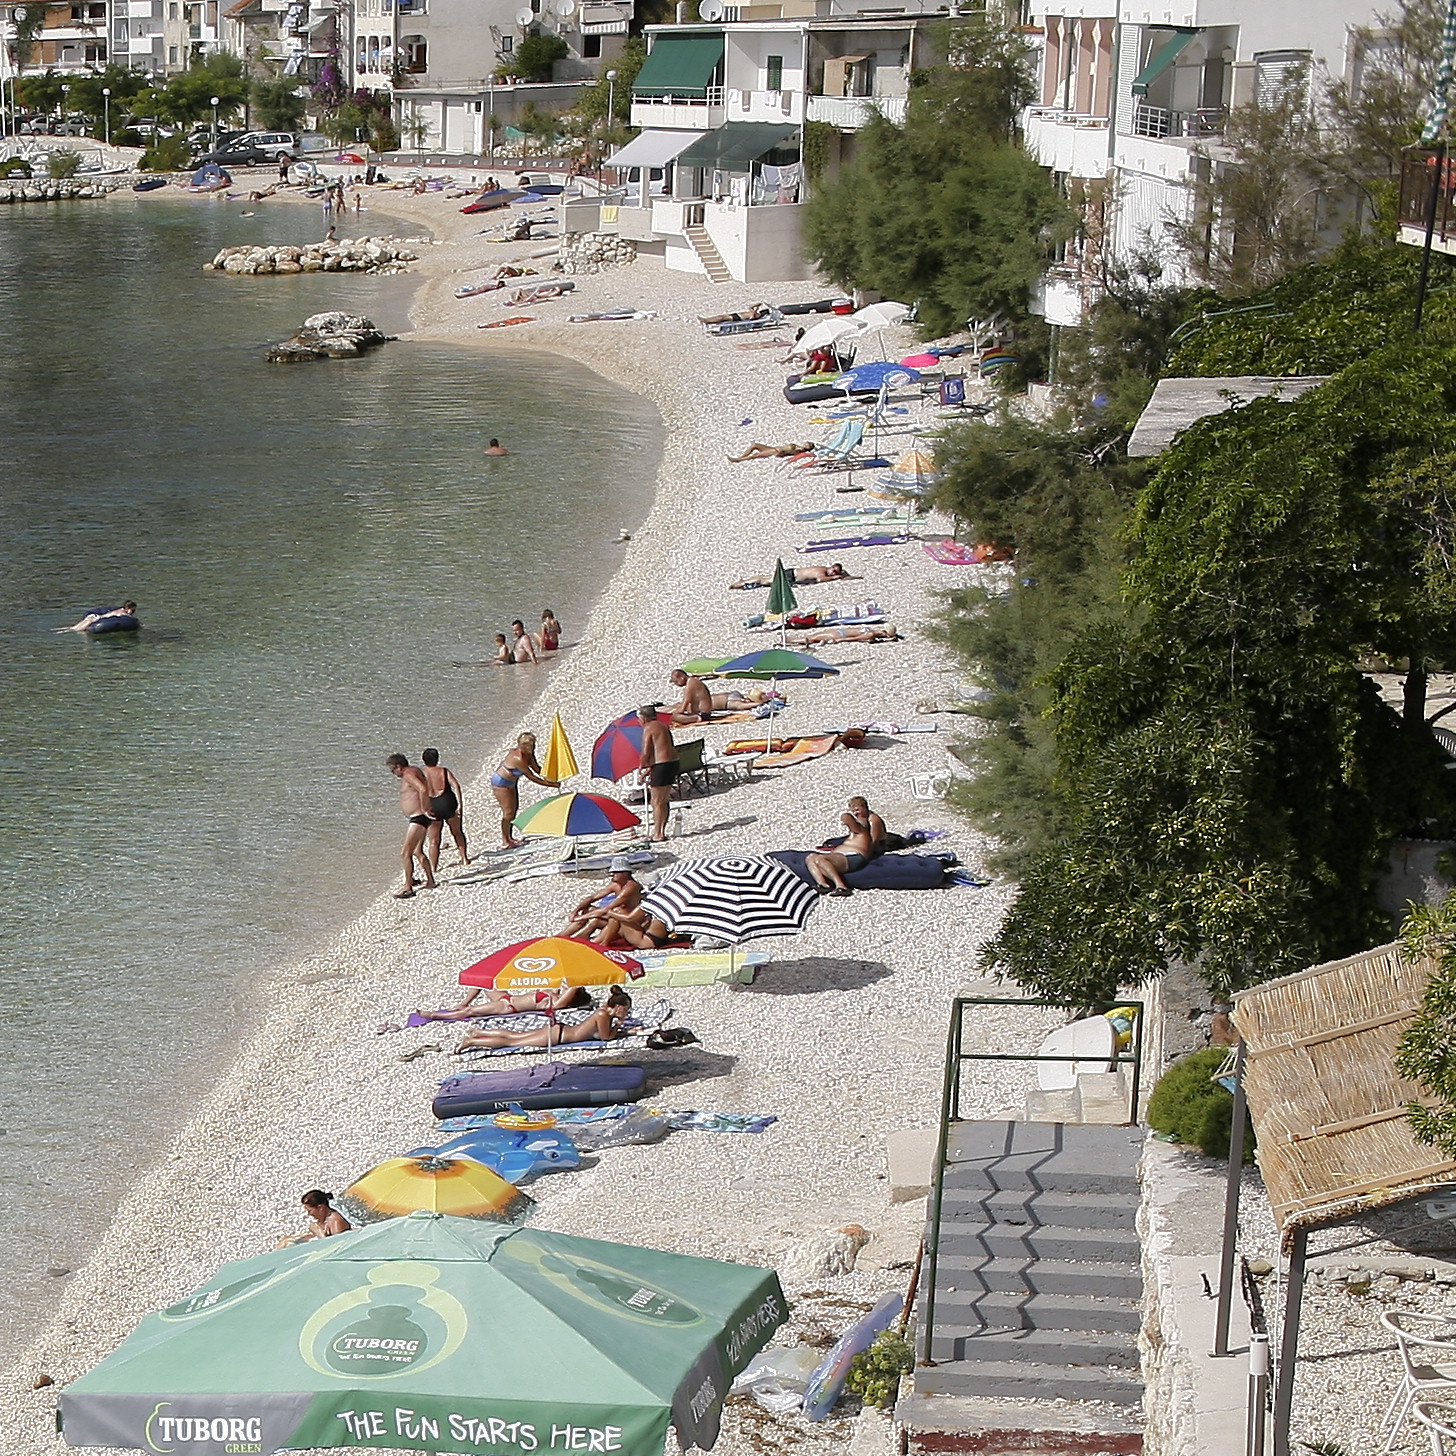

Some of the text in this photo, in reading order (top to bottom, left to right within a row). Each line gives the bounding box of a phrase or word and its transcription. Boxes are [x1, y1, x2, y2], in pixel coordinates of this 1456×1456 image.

[344, 1338, 419, 1352] TUBORG
[158, 1417, 262, 1442] TUBORG
[337, 1410, 388, 1440] THE
[448, 1413, 538, 1451] STARTS
[550, 1423, 623, 1453] HERE
[224, 1443, 262, 1454] GREEN
